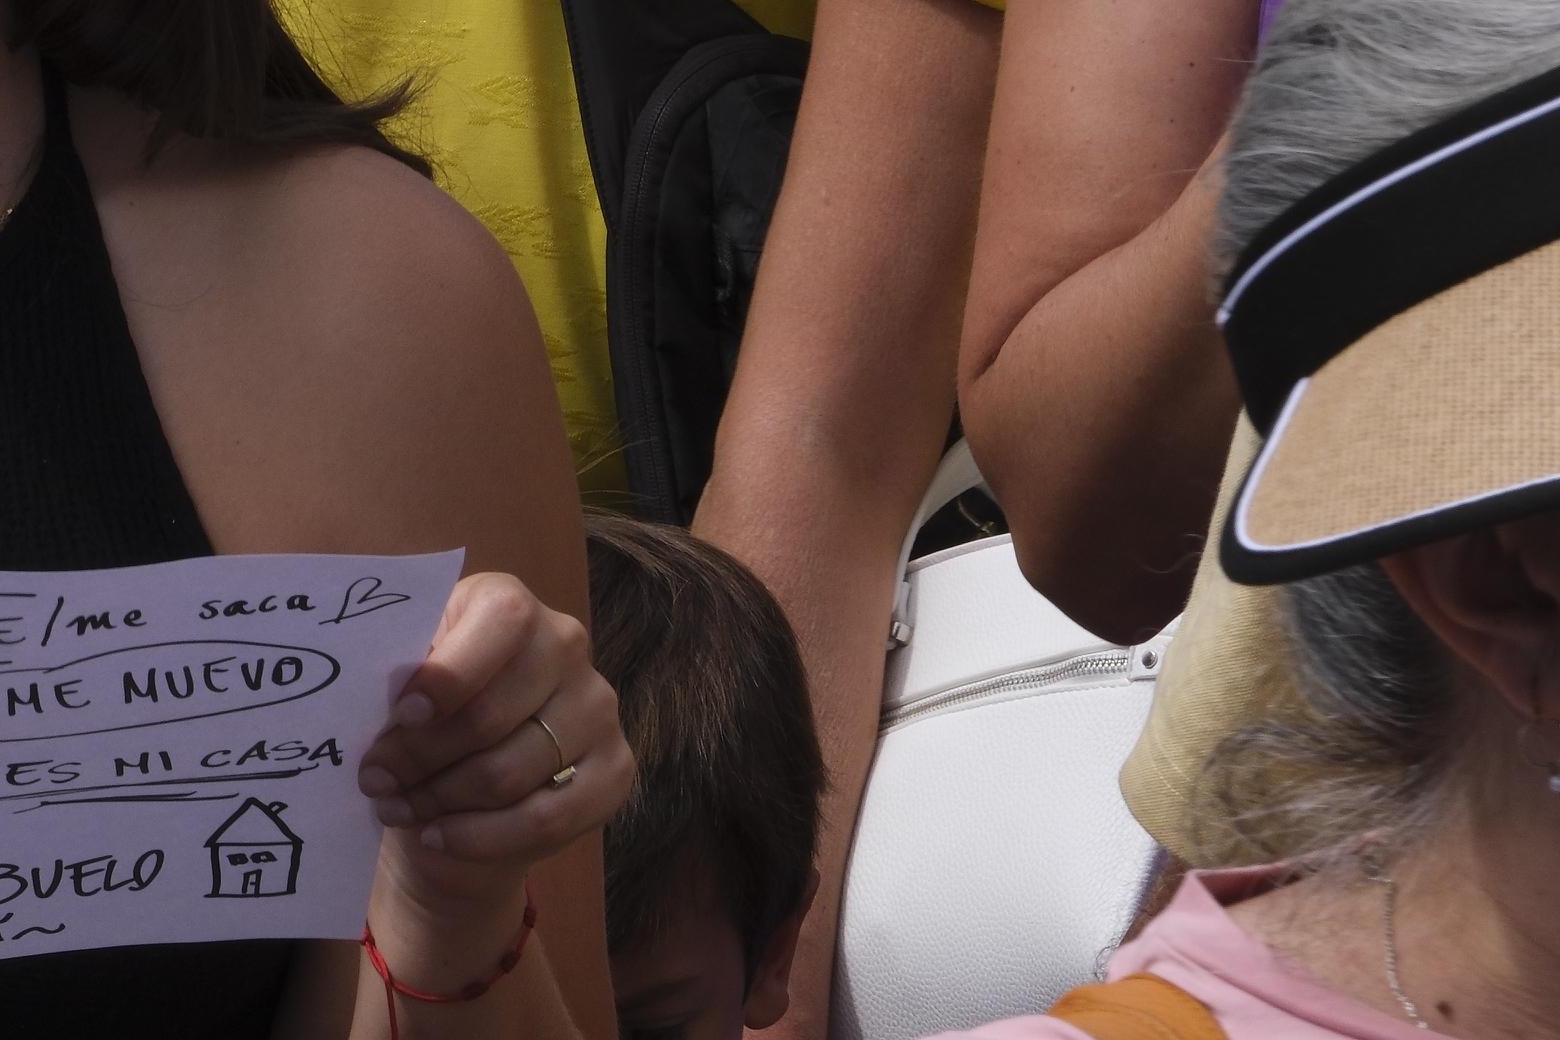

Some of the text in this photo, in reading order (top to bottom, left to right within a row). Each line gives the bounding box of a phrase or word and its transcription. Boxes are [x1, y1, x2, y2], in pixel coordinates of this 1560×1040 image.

[199, 592, 318, 618] saca
[7, 680, 91, 717] ME
[123, 657, 304, 702] MUEVO
[5, 761, 82, 787] ES
[116, 750, 172, 775] MI
[200, 738, 344, 768] CASA
